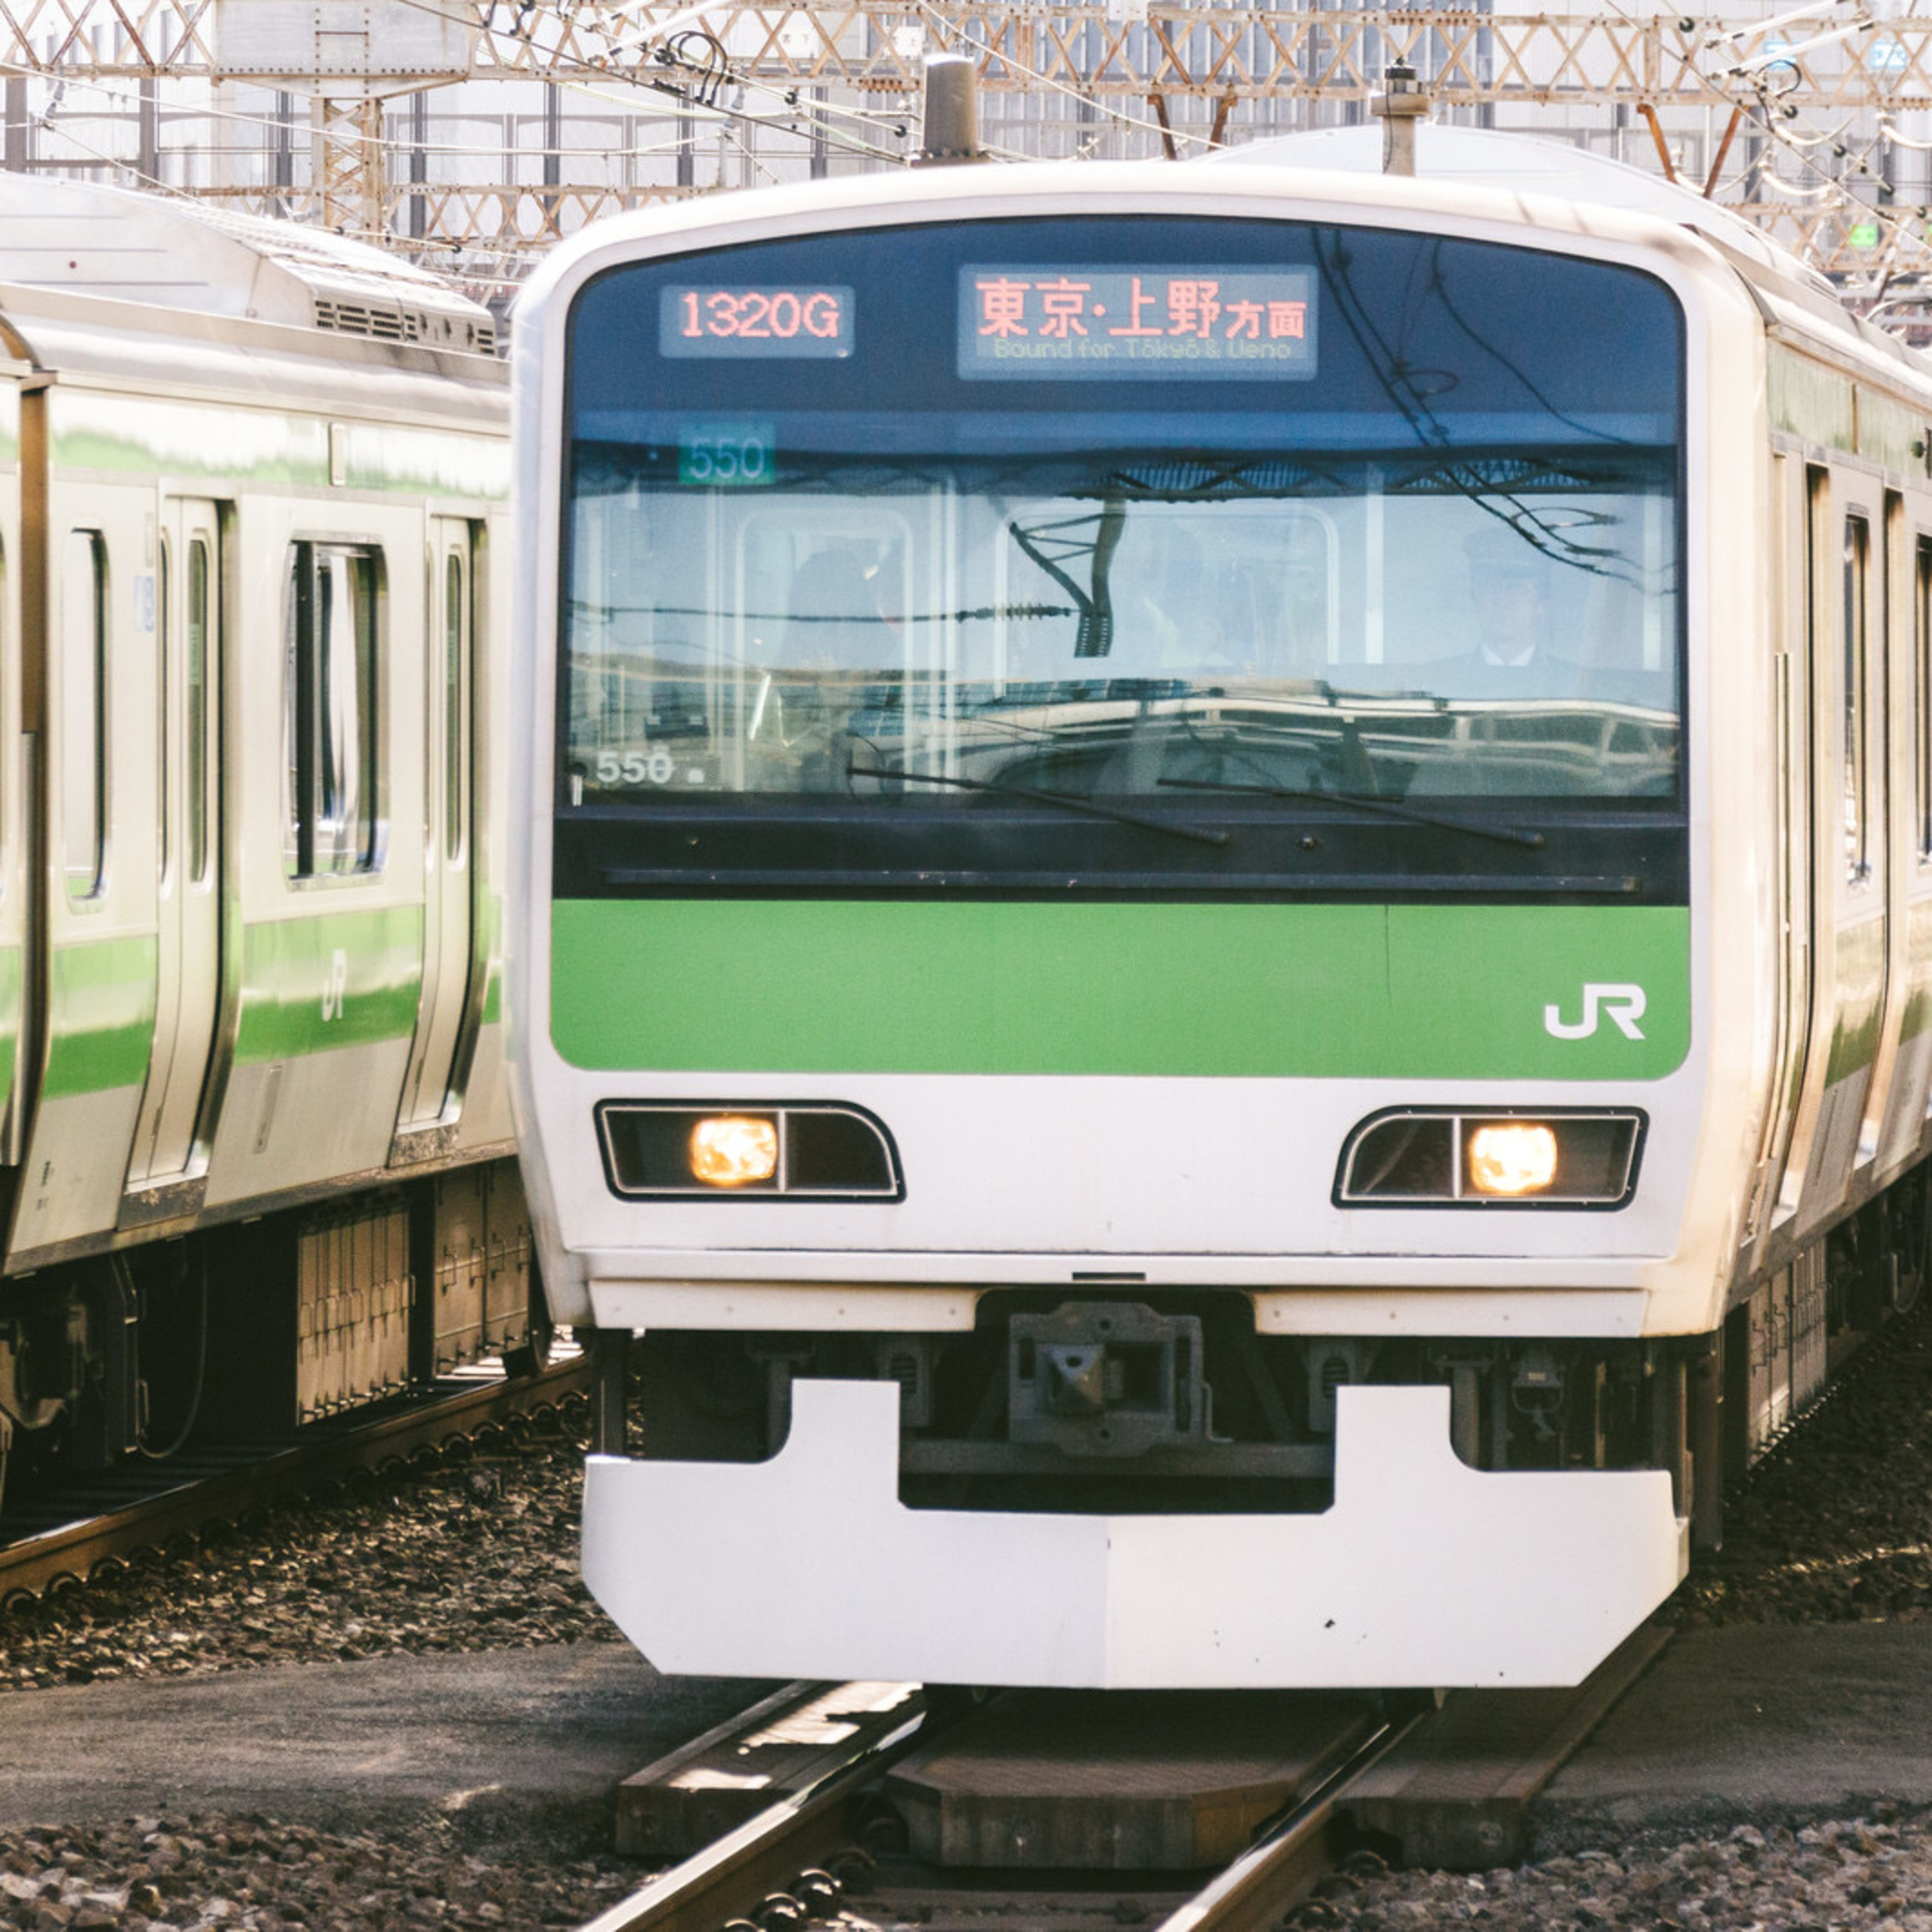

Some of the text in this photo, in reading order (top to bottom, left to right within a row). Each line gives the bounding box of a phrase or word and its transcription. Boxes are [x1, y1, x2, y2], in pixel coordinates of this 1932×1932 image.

[682, 292, 839, 337] 1320G
[975, 276, 1307, 339] 東京・上野方面
[994, 338, 1073, 359] Bound
[1077, 338, 1115, 359] for
[1228, 338, 1291, 359] Ueno
[690, 436, 764, 479] 550
[322, 949, 346, 1022] JR
[1544, 983, 1647, 1040] JR
